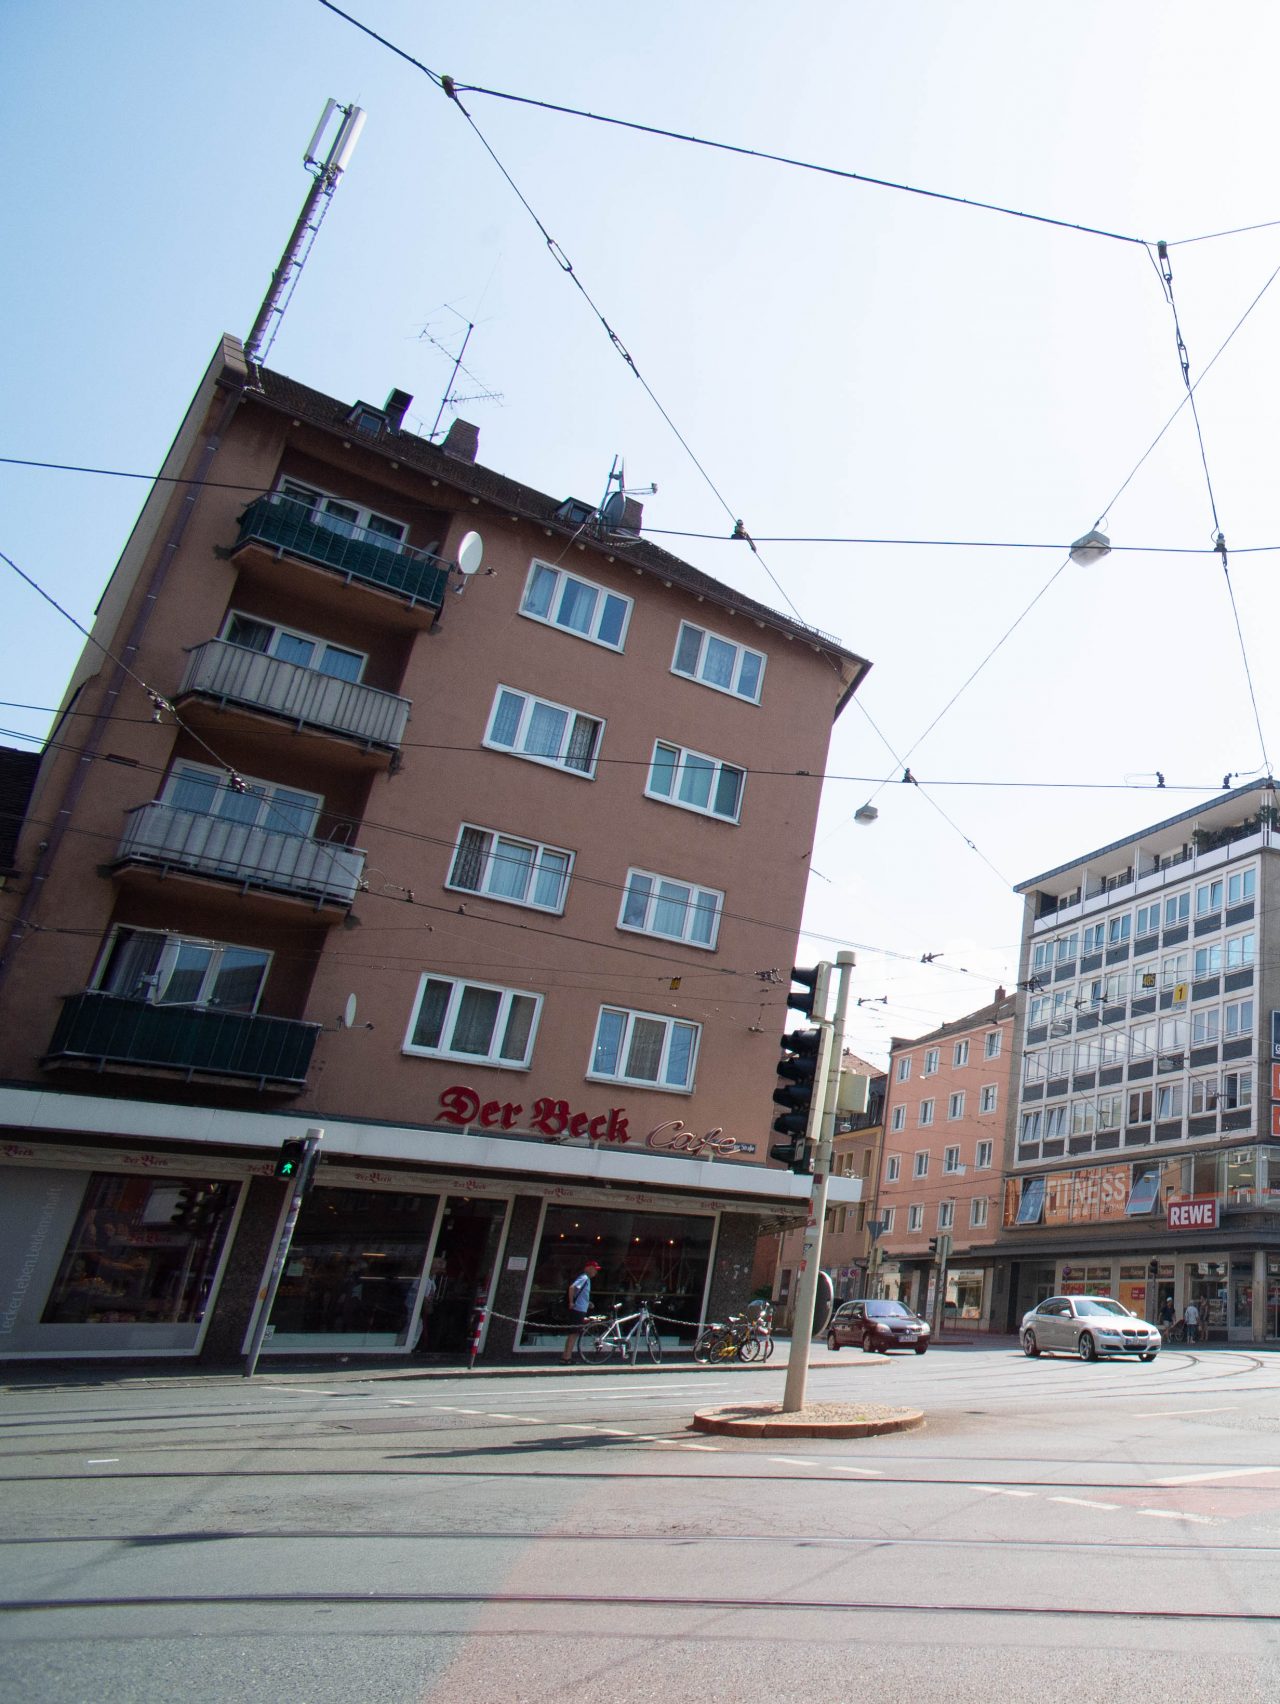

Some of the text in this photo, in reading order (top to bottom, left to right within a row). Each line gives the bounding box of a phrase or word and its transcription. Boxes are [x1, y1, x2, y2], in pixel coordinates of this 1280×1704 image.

[434, 1085, 631, 1143] Der Beck
[1047, 1173, 1126, 1208] FITNESS
[1170, 1204, 1213, 1225] REWE
